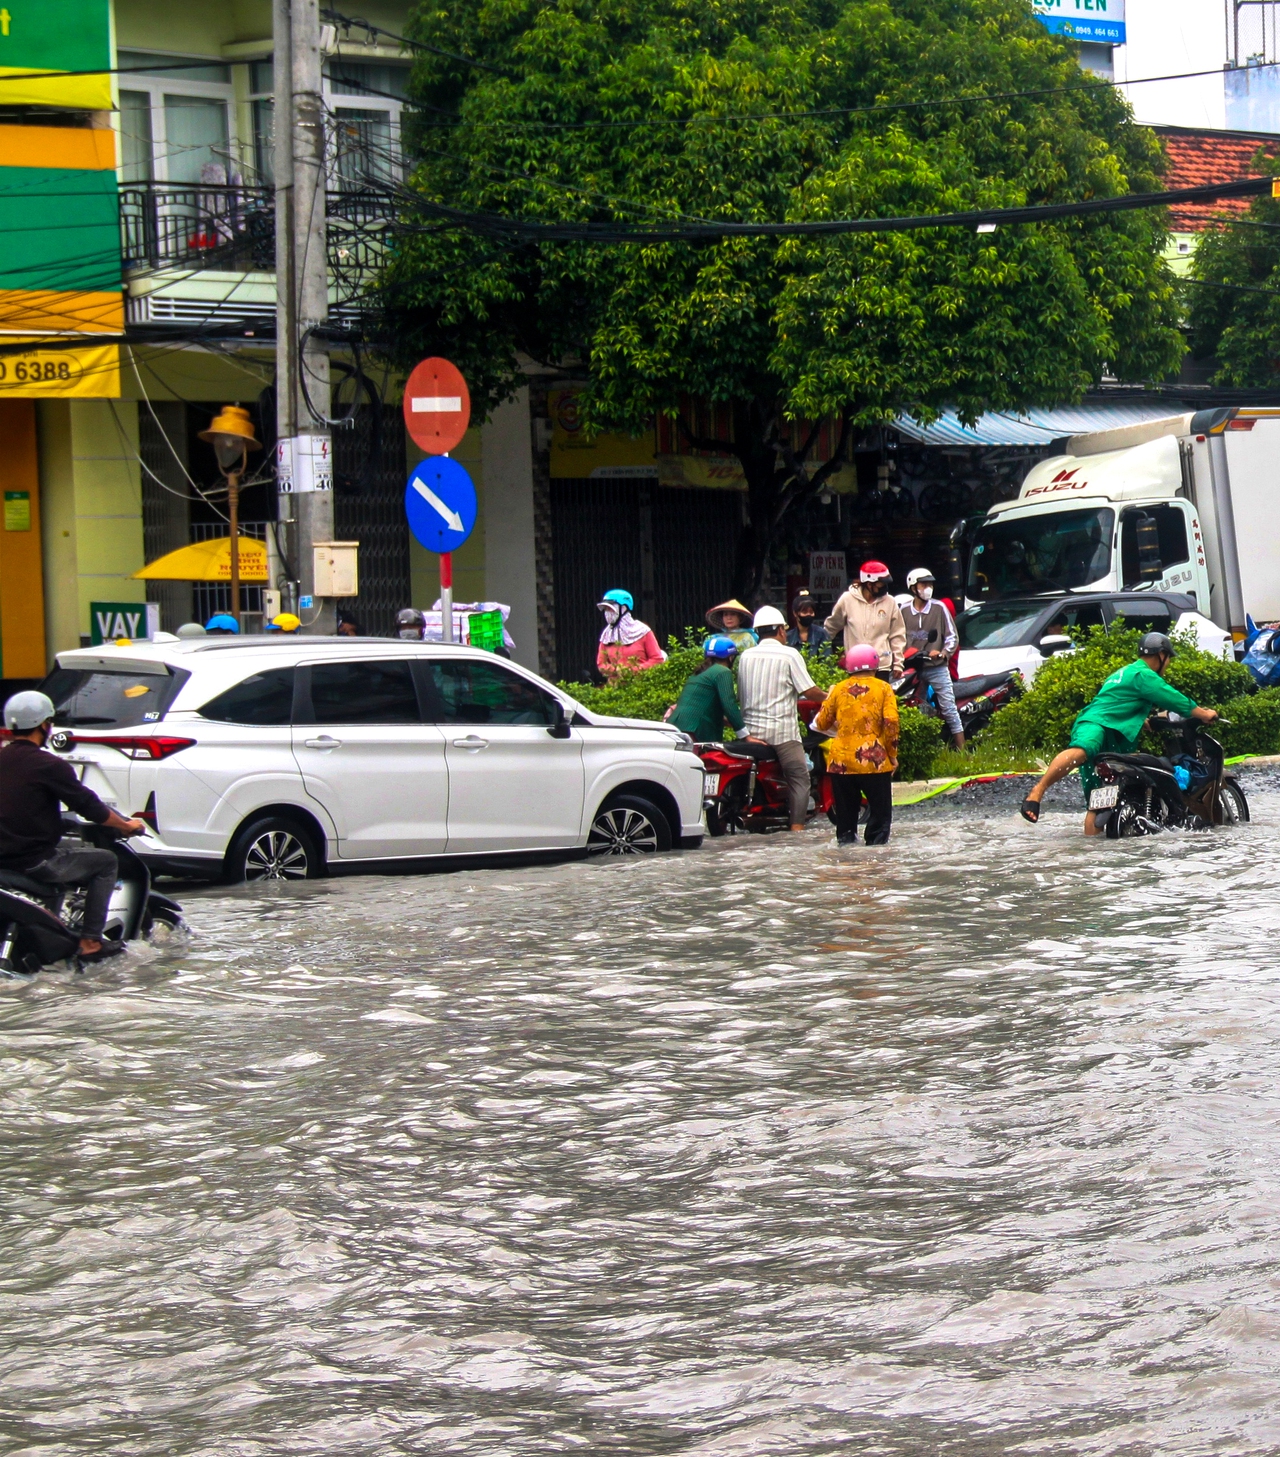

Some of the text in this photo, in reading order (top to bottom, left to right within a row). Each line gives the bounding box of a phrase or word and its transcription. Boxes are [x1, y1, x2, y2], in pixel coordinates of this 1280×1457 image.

[1075, 26, 1093, 35] 0949.
[1094, 28, 1106, 37] 464
[1107, 29, 1119, 38] 663
[15, 361, 71, 381] 6388
[1025, 481, 1088, 498] ISUZU
[96, 612, 141, 639] VAY
